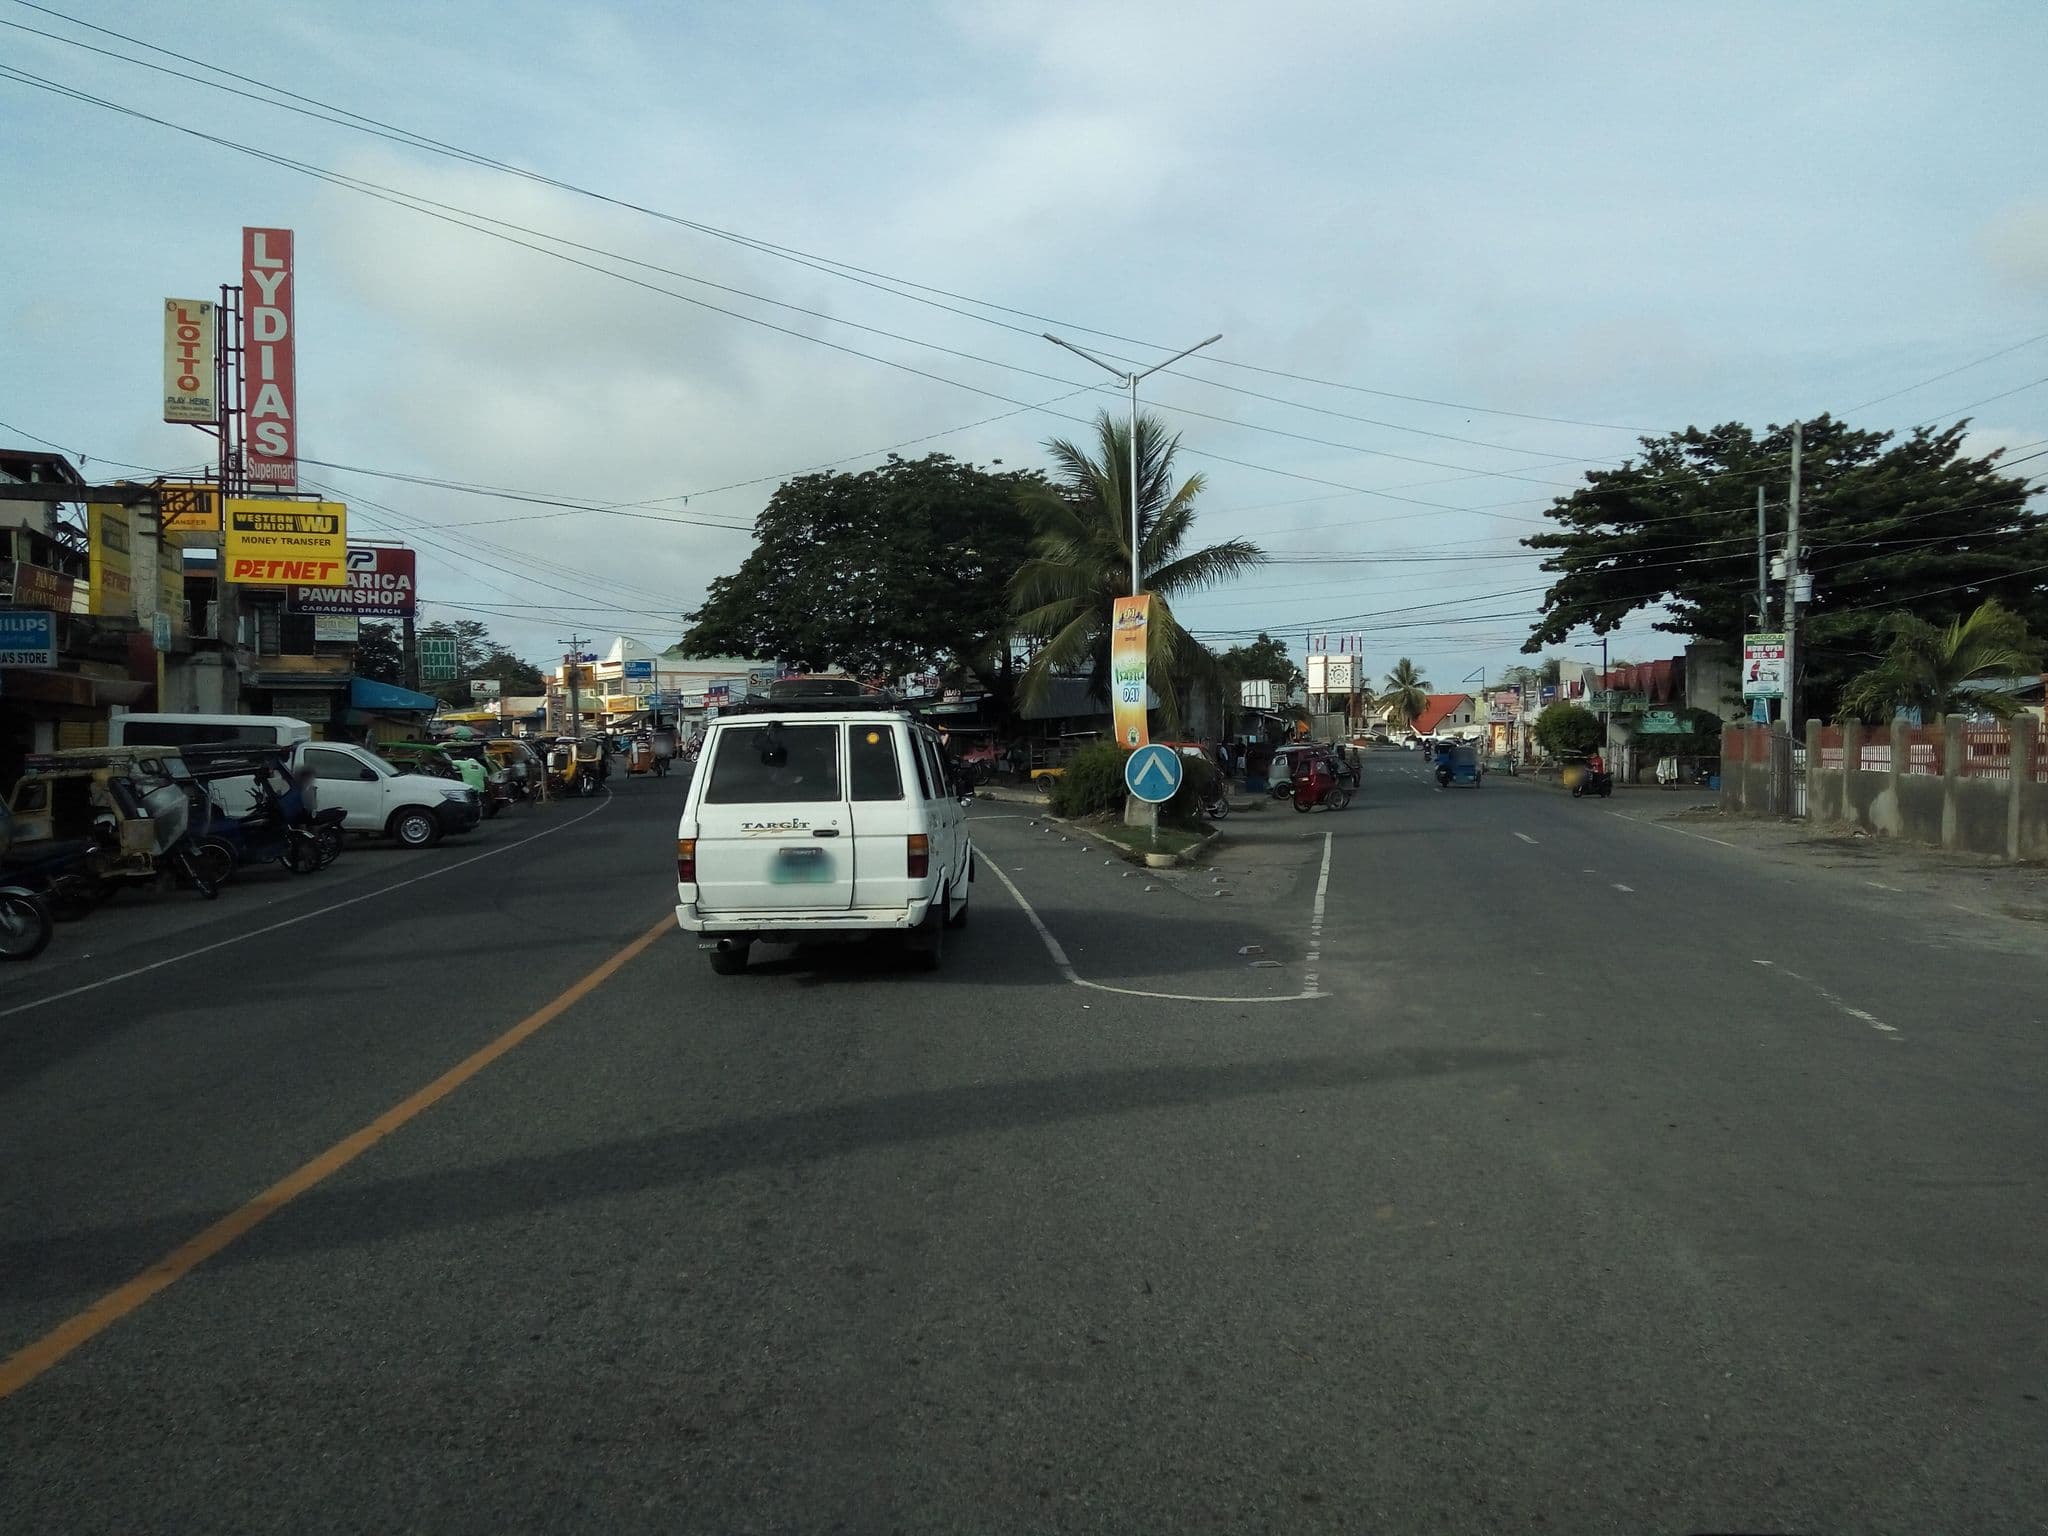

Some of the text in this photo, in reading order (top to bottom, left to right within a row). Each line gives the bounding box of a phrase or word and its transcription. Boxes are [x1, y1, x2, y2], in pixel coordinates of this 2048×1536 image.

[177, 309, 200, 391] LOTTO
[250, 232, 290, 458] LYDIAS
[249, 457, 294, 480] Supermart
[236, 514, 293, 523] WESTERN
[300, 516, 333, 533] WU
[255, 523, 293, 531] UNION
[241, 536, 331, 547] MONEY TRANSFER
[233, 559, 339, 580] PETNET
[347, 573, 412, 590] ARICA
[298, 587, 406, 605] PAWNSHOP
[301, 605, 401, 615] CABAGAN BRANCH
[0, 618, 48, 632] ILIPS
[17, 652, 48, 664] STORE
[741, 818, 810, 829] TARGET
